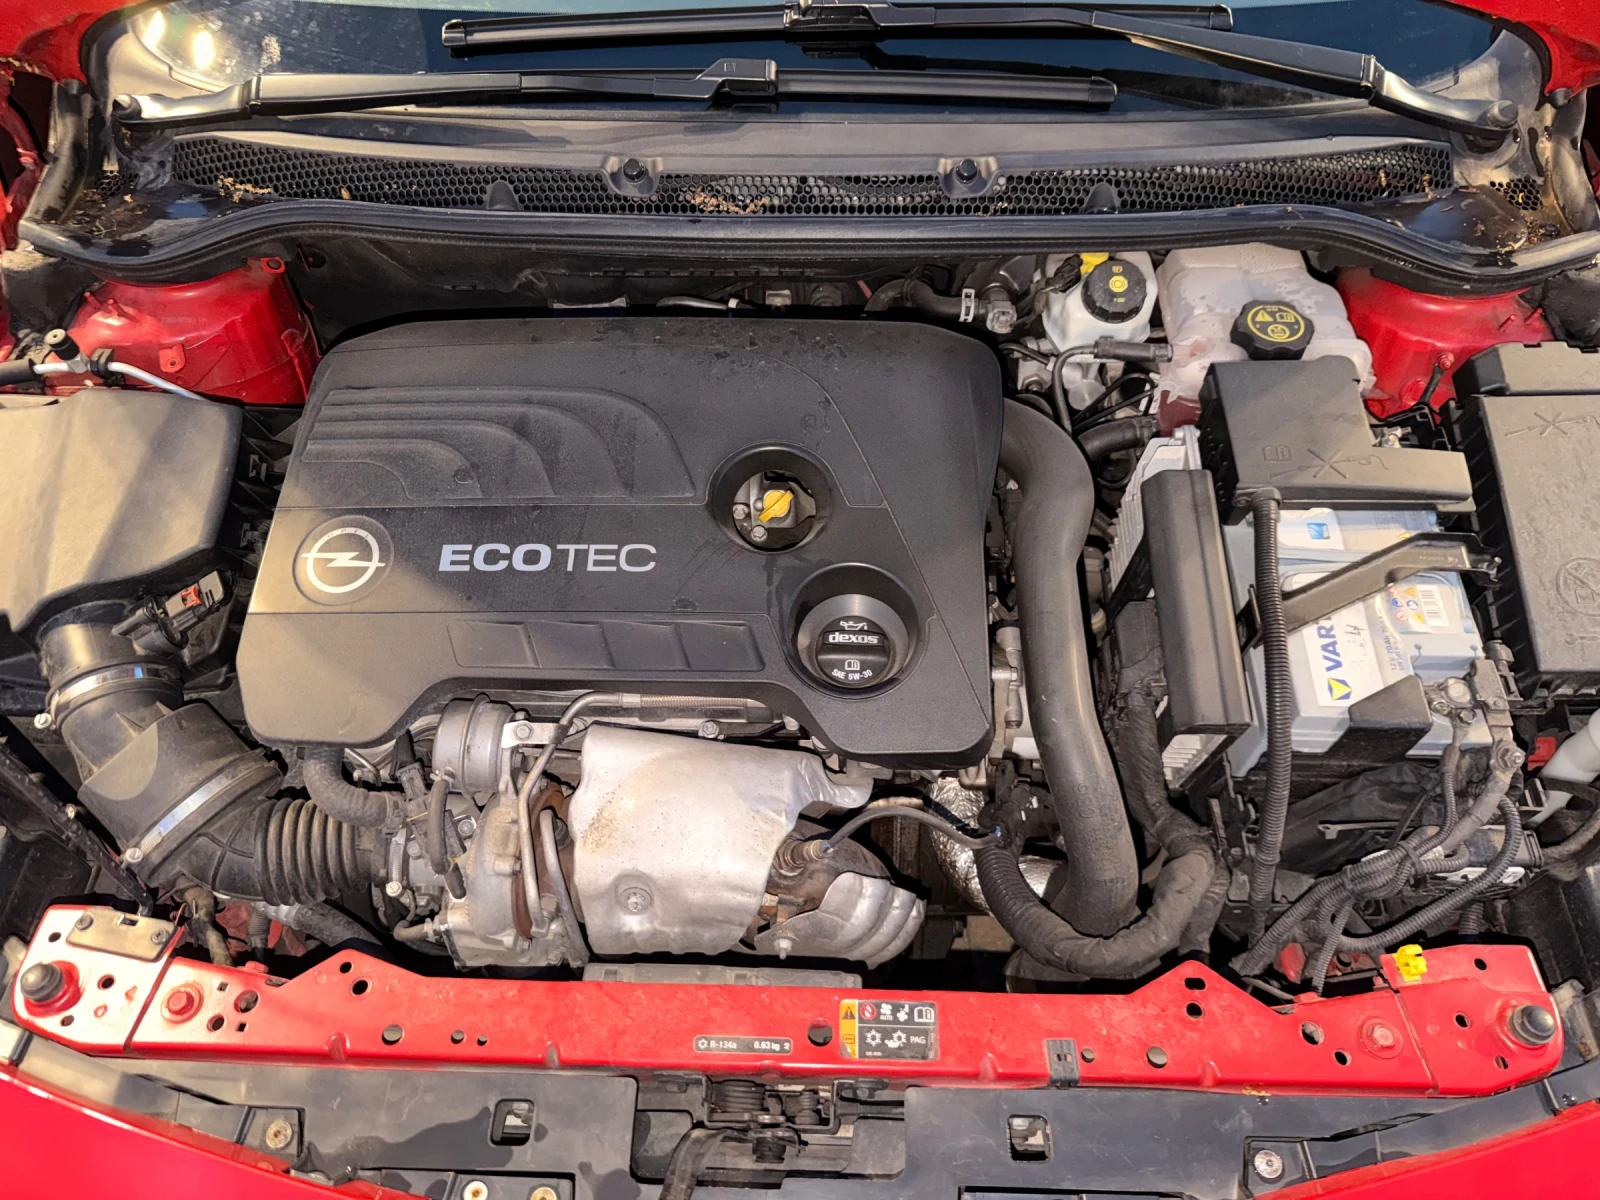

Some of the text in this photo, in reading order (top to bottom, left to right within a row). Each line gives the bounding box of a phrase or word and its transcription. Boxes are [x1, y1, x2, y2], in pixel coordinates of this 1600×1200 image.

[438, 543, 657, 572] ECOTEC
[828, 632, 880, 644] dexos
[831, 668, 873, 680] SAE 5W-30
[909, 1035, 927, 1044] PAG
[709, 1040, 738, 1049] R-134a
[753, 1040, 771, 1050] 0.63
[771, 1042, 781, 1052] kg
